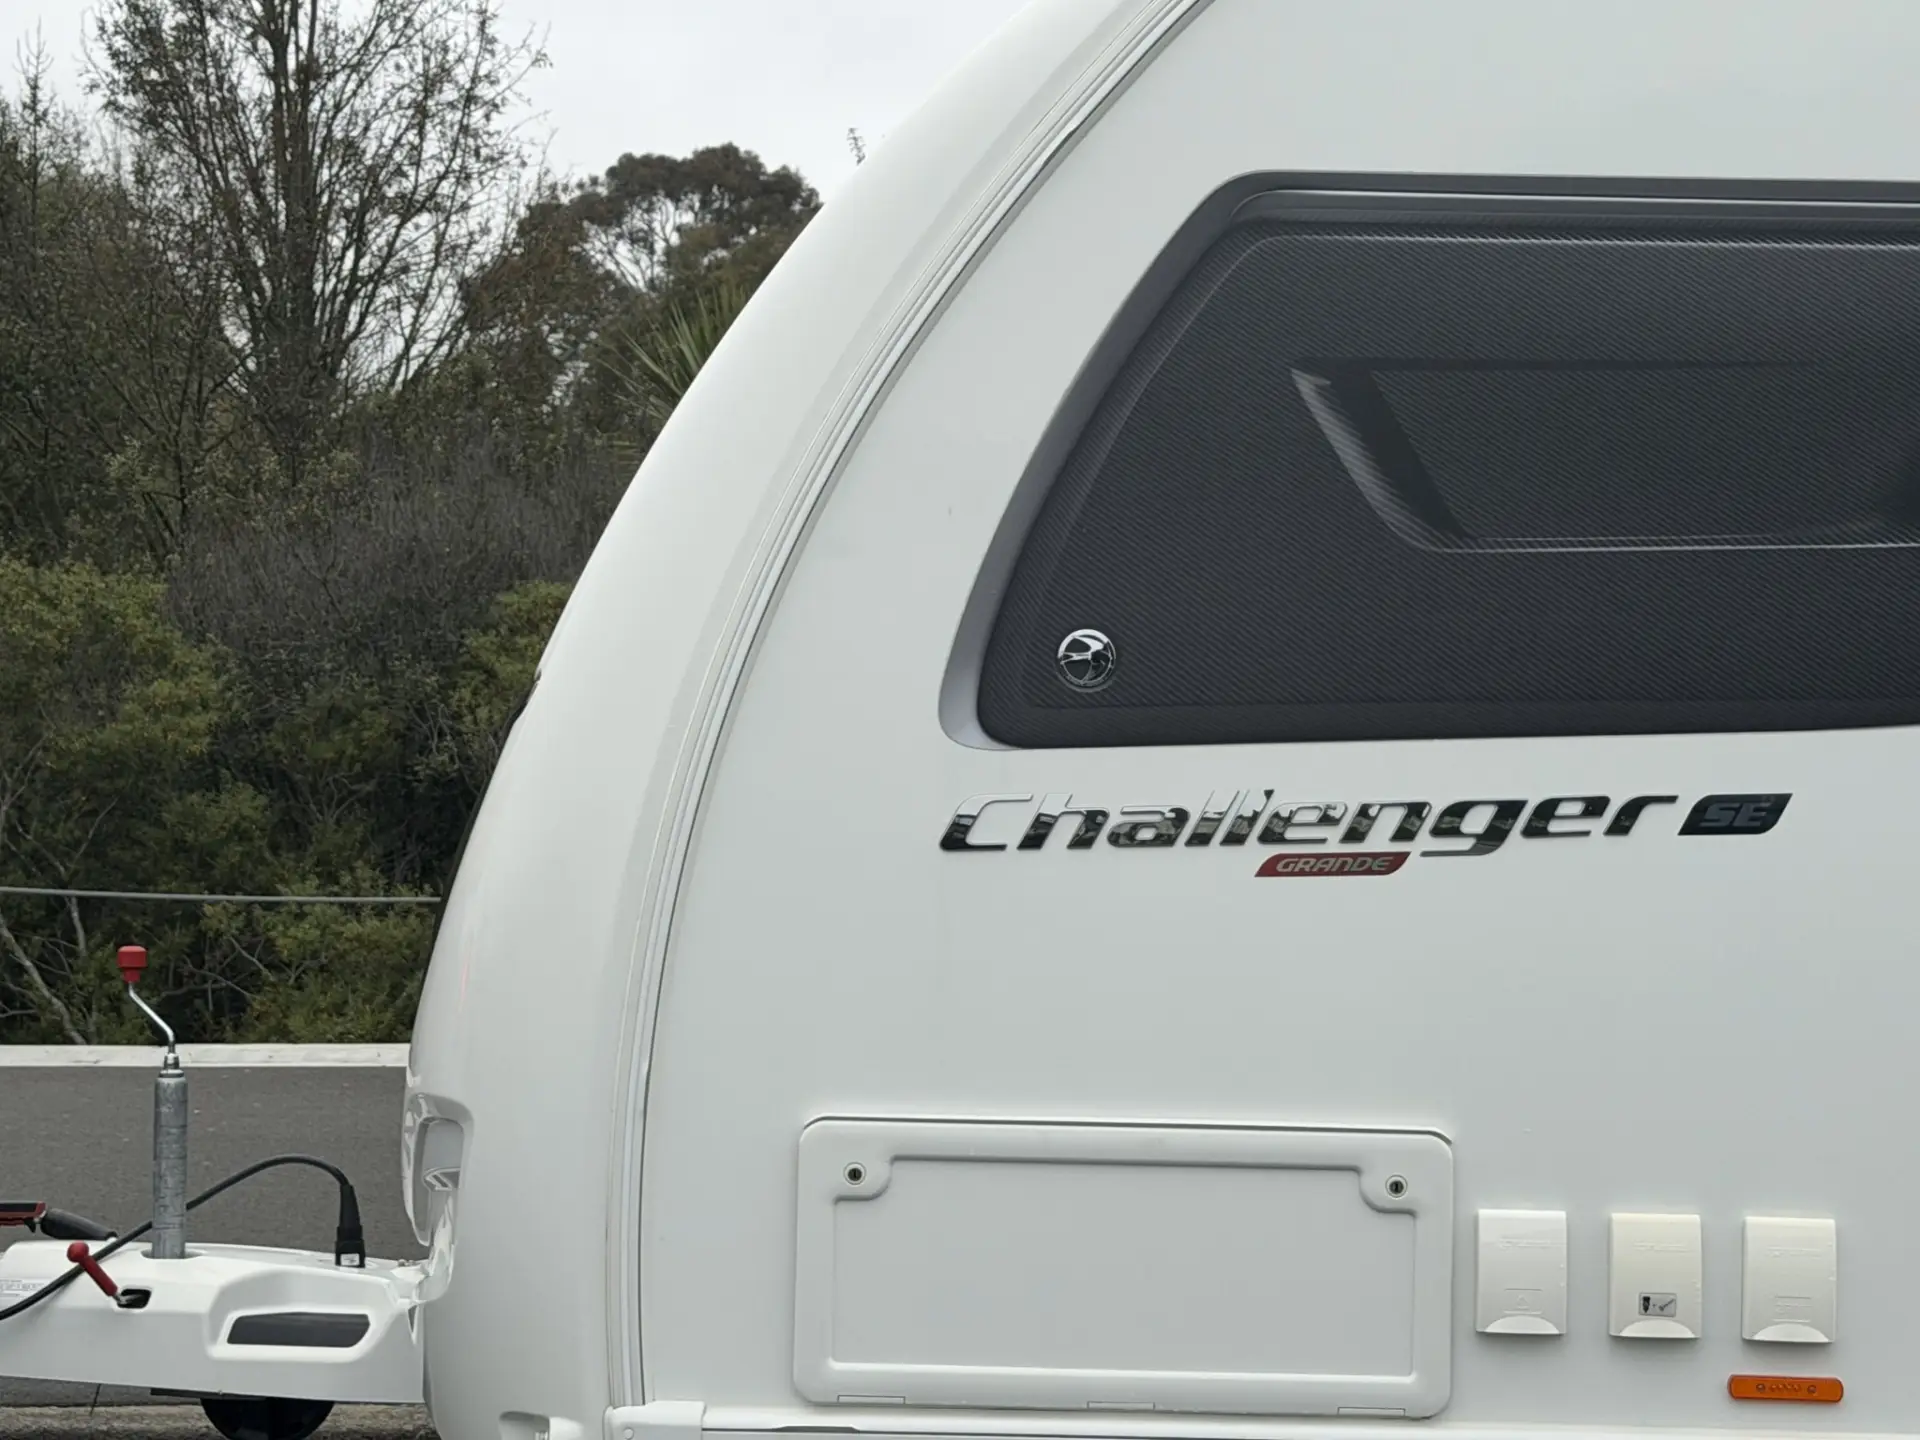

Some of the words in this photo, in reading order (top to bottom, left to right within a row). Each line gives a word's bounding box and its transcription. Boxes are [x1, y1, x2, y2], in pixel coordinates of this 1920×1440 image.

[939, 789, 1679, 857] Challenger
[1700, 803, 1772, 827] SE
[1276, 857, 1393, 872] GRANDE
